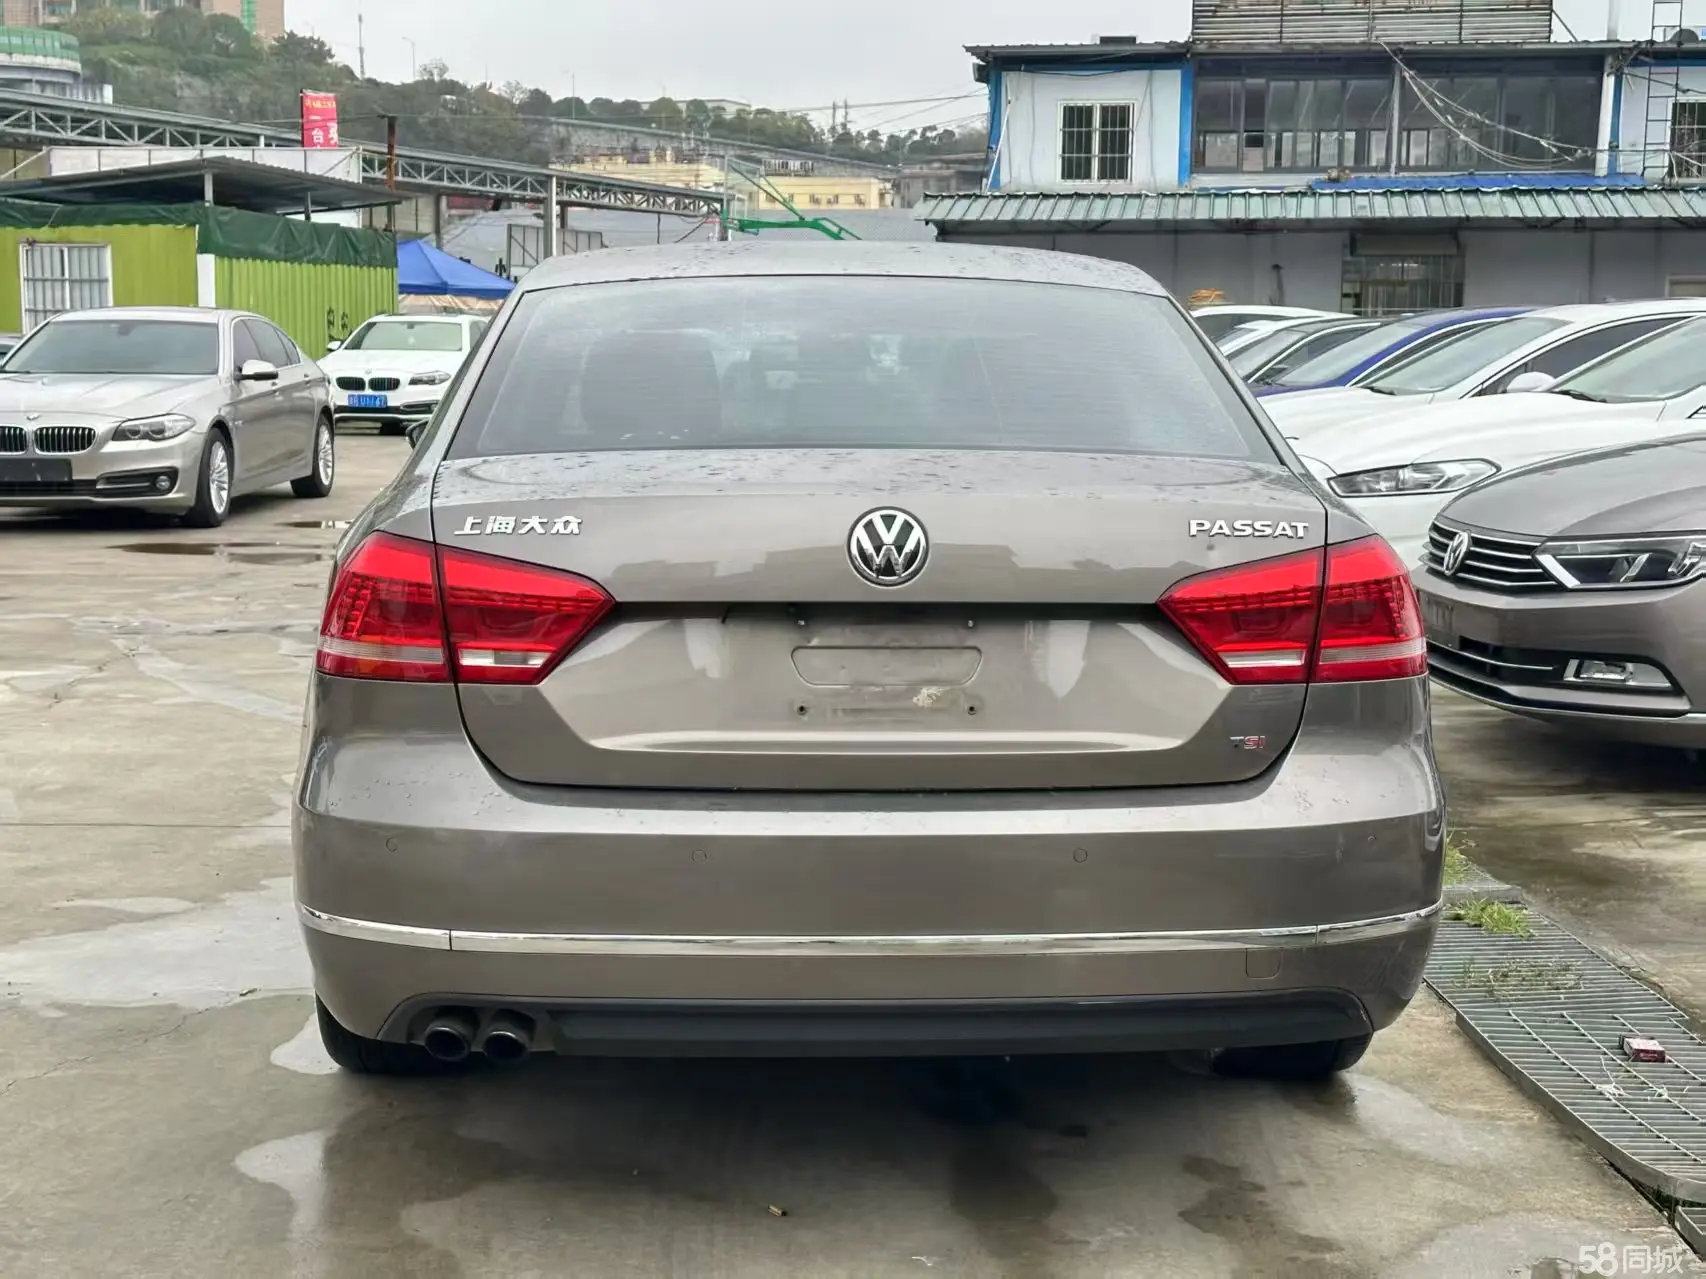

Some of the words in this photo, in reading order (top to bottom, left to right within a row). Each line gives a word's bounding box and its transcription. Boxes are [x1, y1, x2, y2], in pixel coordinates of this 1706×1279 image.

[453, 515, 583, 536] 上海大众
[1189, 519, 1310, 539] PASSAT
[1229, 735, 1266, 750] TSI
